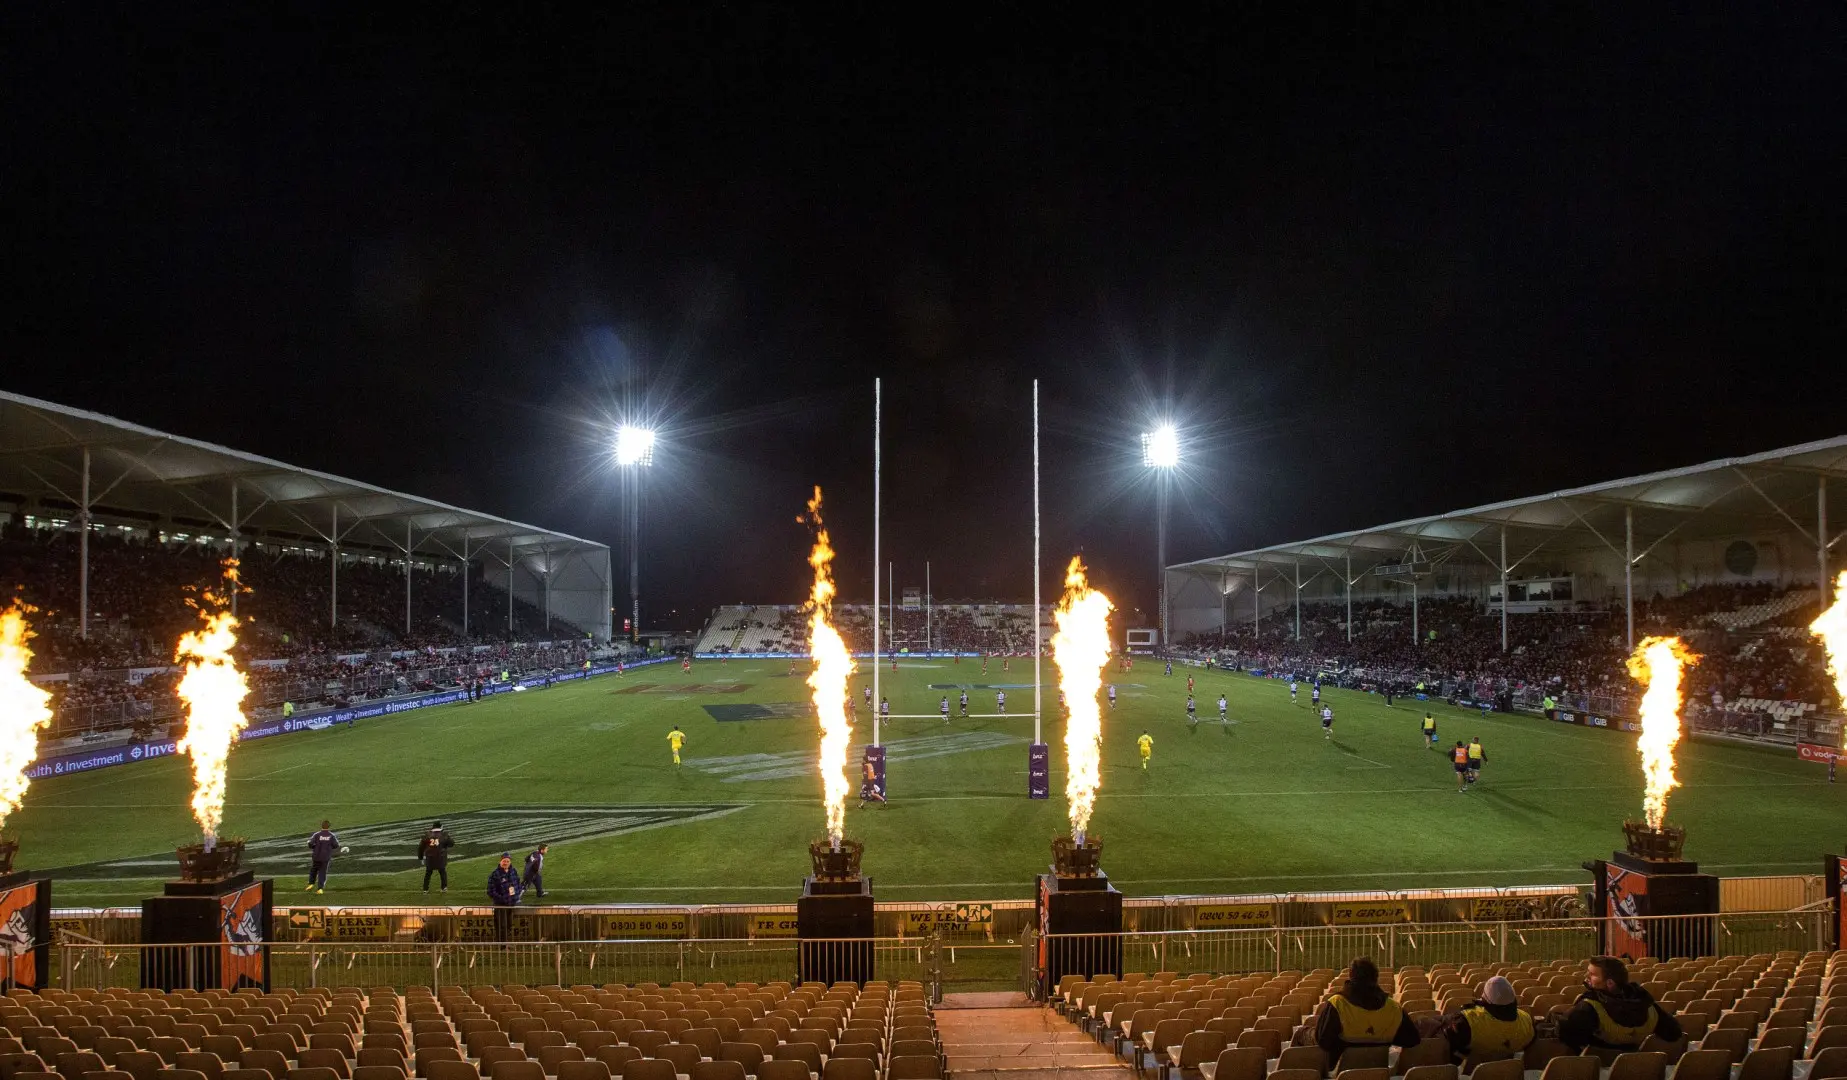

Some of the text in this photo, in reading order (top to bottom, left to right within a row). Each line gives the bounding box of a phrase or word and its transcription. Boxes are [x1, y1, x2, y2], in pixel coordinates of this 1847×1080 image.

[391, 699, 420, 713] Investec
[1562, 713, 1575, 722] GIB
[1594, 717, 1607, 727] GIB
[292, 715, 333, 730] Investec
[144, 742, 176, 758] Inve
[24, 752, 124, 779] ealth & Investment
[910, 913, 933, 922] WE
[1199, 911, 1225, 920] 0800
[1226, 911, 1240, 920] 50
[1336, 908, 1405, 918] TR GROUP
[338, 917, 382, 927] LEASE
[671, 921, 684, 930] 50
[757, 921, 774, 930] TR
[919, 922, 927, 931] &
[339, 927, 376, 936] RENT
